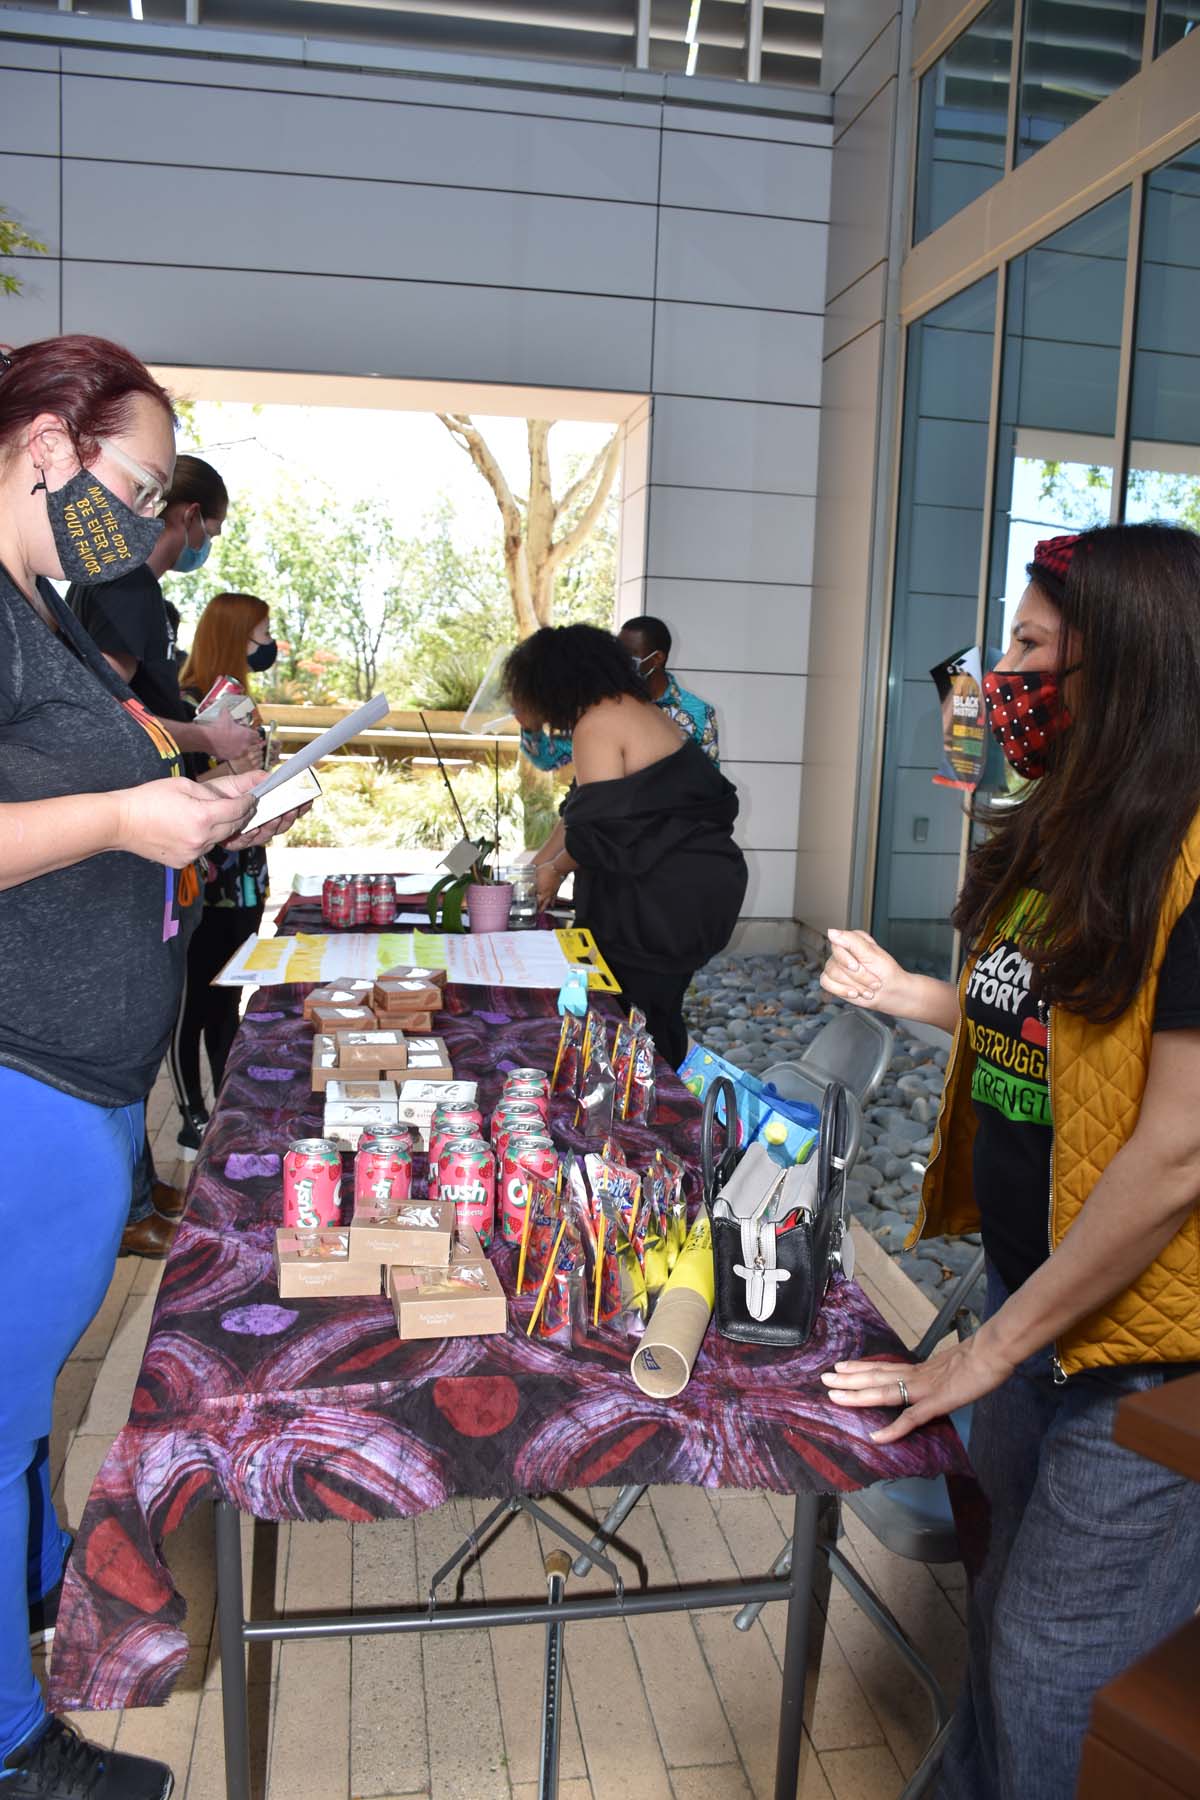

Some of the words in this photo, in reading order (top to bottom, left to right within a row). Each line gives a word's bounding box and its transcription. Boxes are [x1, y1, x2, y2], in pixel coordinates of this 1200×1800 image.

[63, 503, 84, 538] YOUR
[75, 540, 101, 576] FAVOR
[76, 497, 95, 517] BE
[87, 518, 109, 551] EVER
[101, 550, 118, 564] IN
[87, 486, 109, 508] MAY
[101, 511, 119, 533] THE
[111, 533, 132, 559] ODDS
[952, 695, 980, 708] BLACK
[966, 972, 1029, 1015] TORY
[974, 945, 1034, 990] ACK
[976, 1024, 1049, 1081] STRUGG
[971, 1064, 1051, 1121] TRENGT
[440, 1179, 487, 1204] rush
